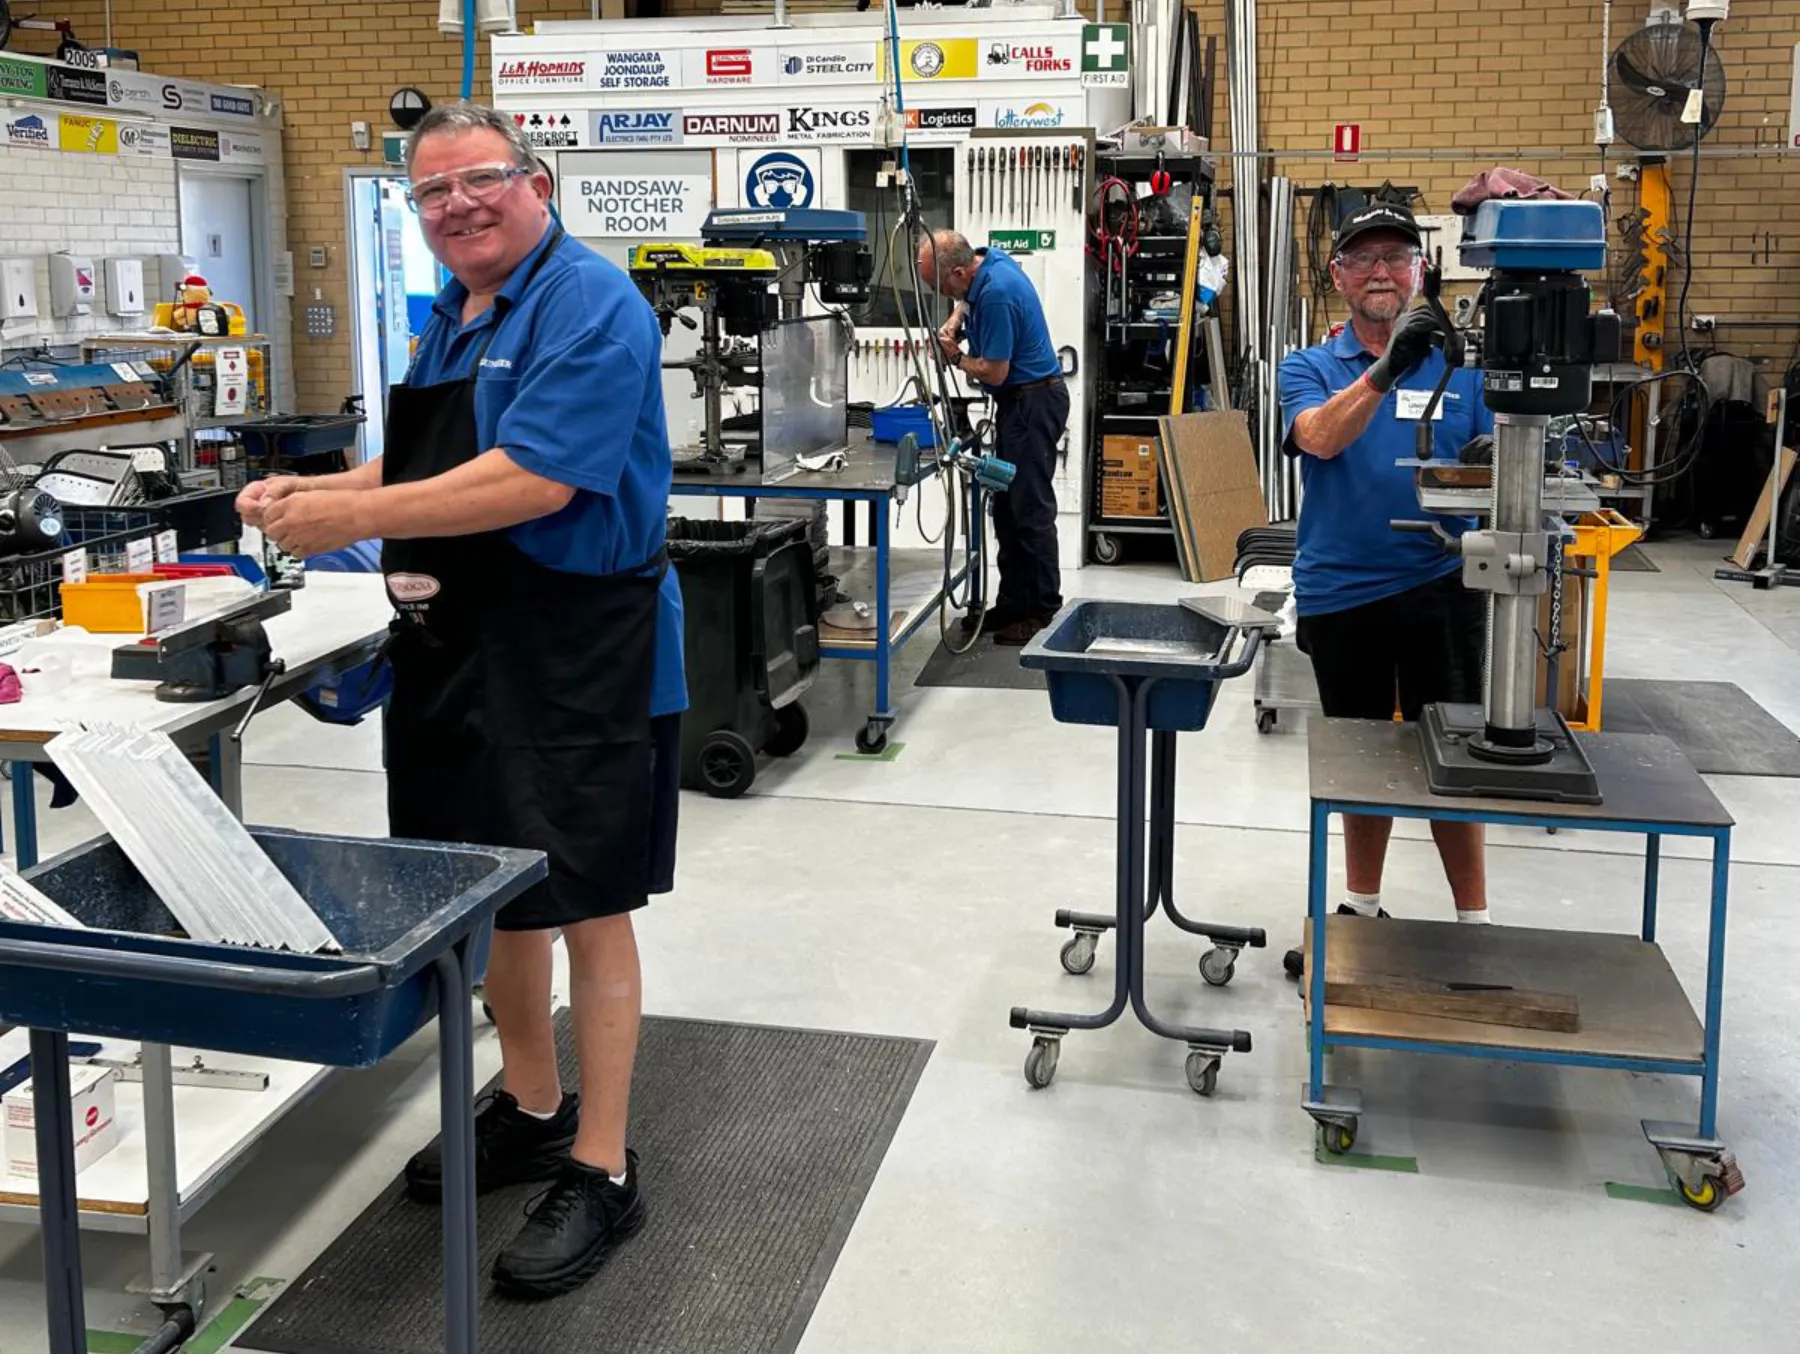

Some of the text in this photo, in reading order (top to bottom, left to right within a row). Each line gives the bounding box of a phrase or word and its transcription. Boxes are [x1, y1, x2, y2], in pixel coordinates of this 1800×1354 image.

[65, 49, 97, 69] 2009
[606, 52, 661, 63] WANGARA
[1011, 47, 1053, 59] CALLS
[603, 63, 665, 75] JOONDALUP
[1026, 59, 1071, 72] FORKS
[533, 76, 584, 84] FURNITURE
[600, 76, 669, 88] SELF STORAGE
[1084, 73, 1126, 83] FIRST AID
[63, 117, 91, 128] FANUC
[686, 116, 778, 133] DARNUM
[787, 107, 870, 132] KINGS
[920, 112, 973, 127] Logistics
[6, 123, 49, 140] Verified
[816, 131, 871, 139] FABRICATION
[172, 132, 218, 147] DIELECTRIC
[728, 134, 778, 143] NOMINEES
[580, 180, 690, 195] BANDSAW-
[587, 197, 684, 213] NOTCHER
[605, 215, 667, 232] ROOM
[991, 238, 1029, 249] First Aid
